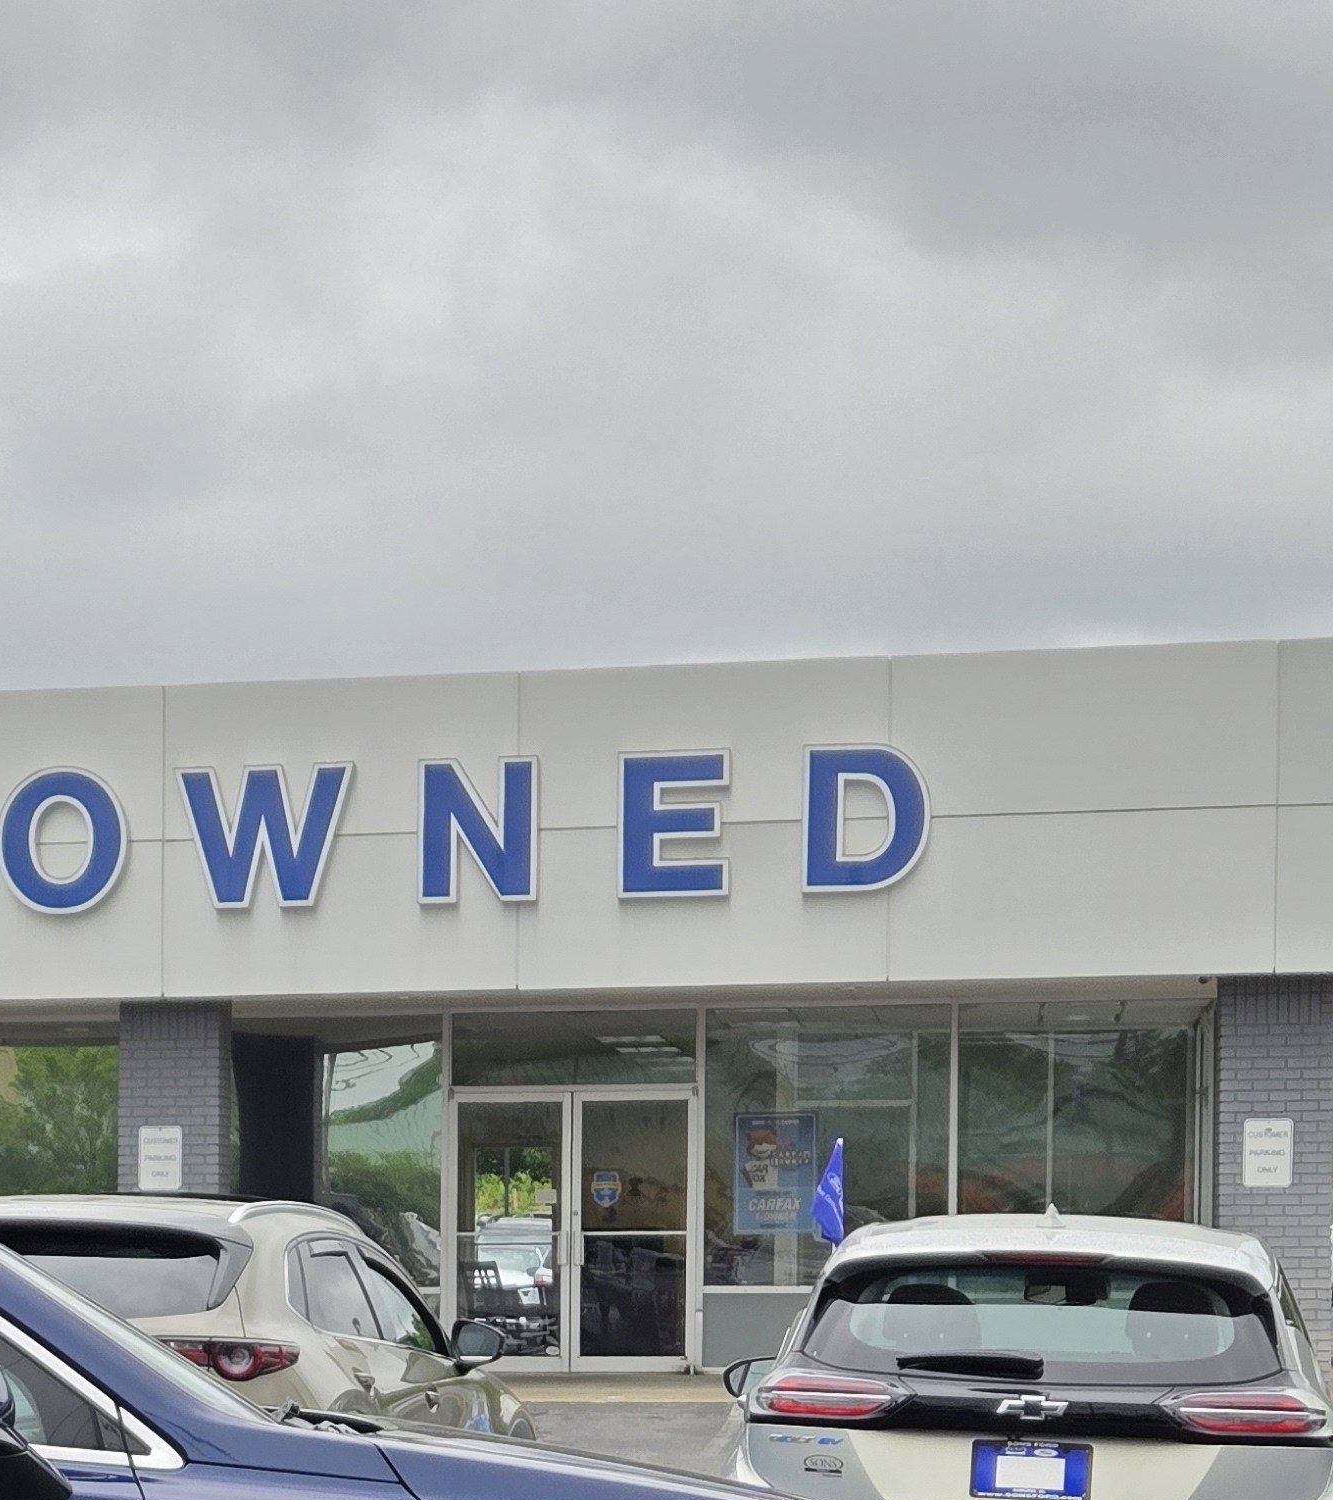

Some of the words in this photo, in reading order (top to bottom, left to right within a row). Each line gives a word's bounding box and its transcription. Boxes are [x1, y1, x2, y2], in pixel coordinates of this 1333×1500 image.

[1247, 1130, 1289, 1139] CUSTOMER
[1256, 1165, 1278, 1173] ONLY
[748, 1197, 802, 1212] CARFAX
